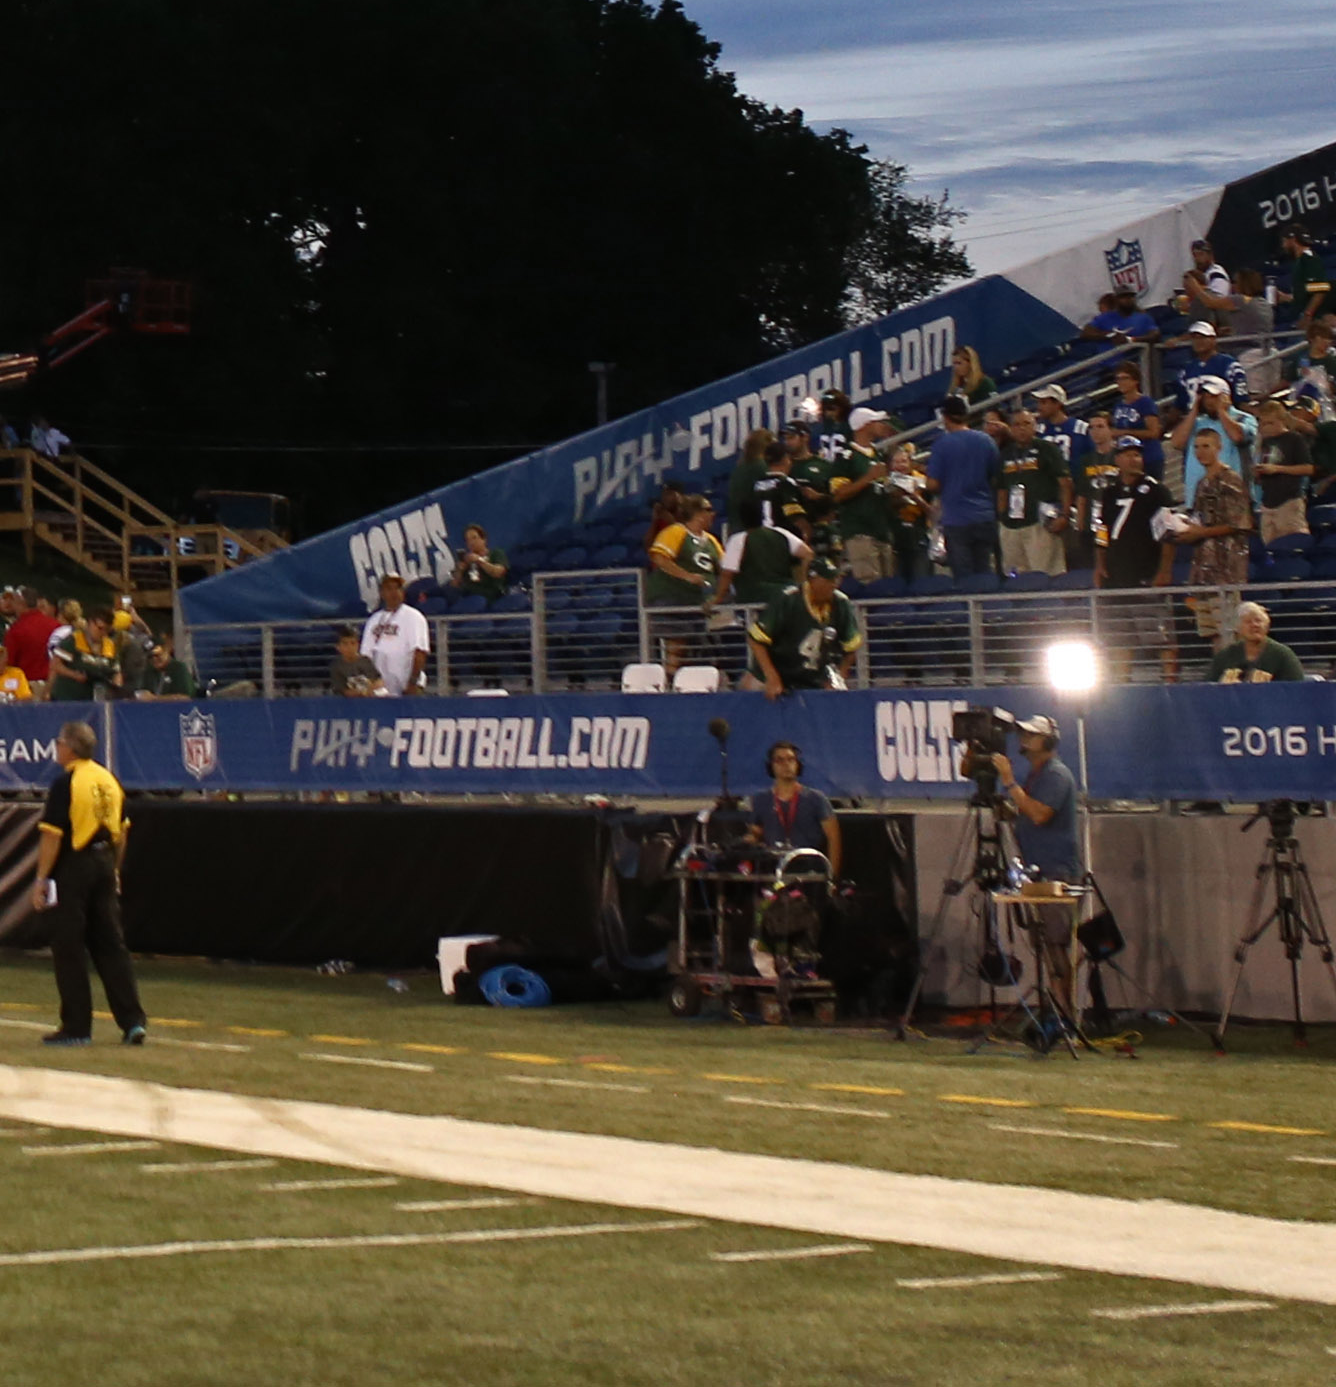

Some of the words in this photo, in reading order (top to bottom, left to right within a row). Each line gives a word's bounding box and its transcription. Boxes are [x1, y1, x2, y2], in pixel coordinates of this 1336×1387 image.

[1258, 182, 1320, 229] 2016
[1110, 497, 1135, 540] 7
[350, 503, 456, 613] COLTS
[798, 627, 824, 670] 4
[1222, 726, 1308, 756] 2016
